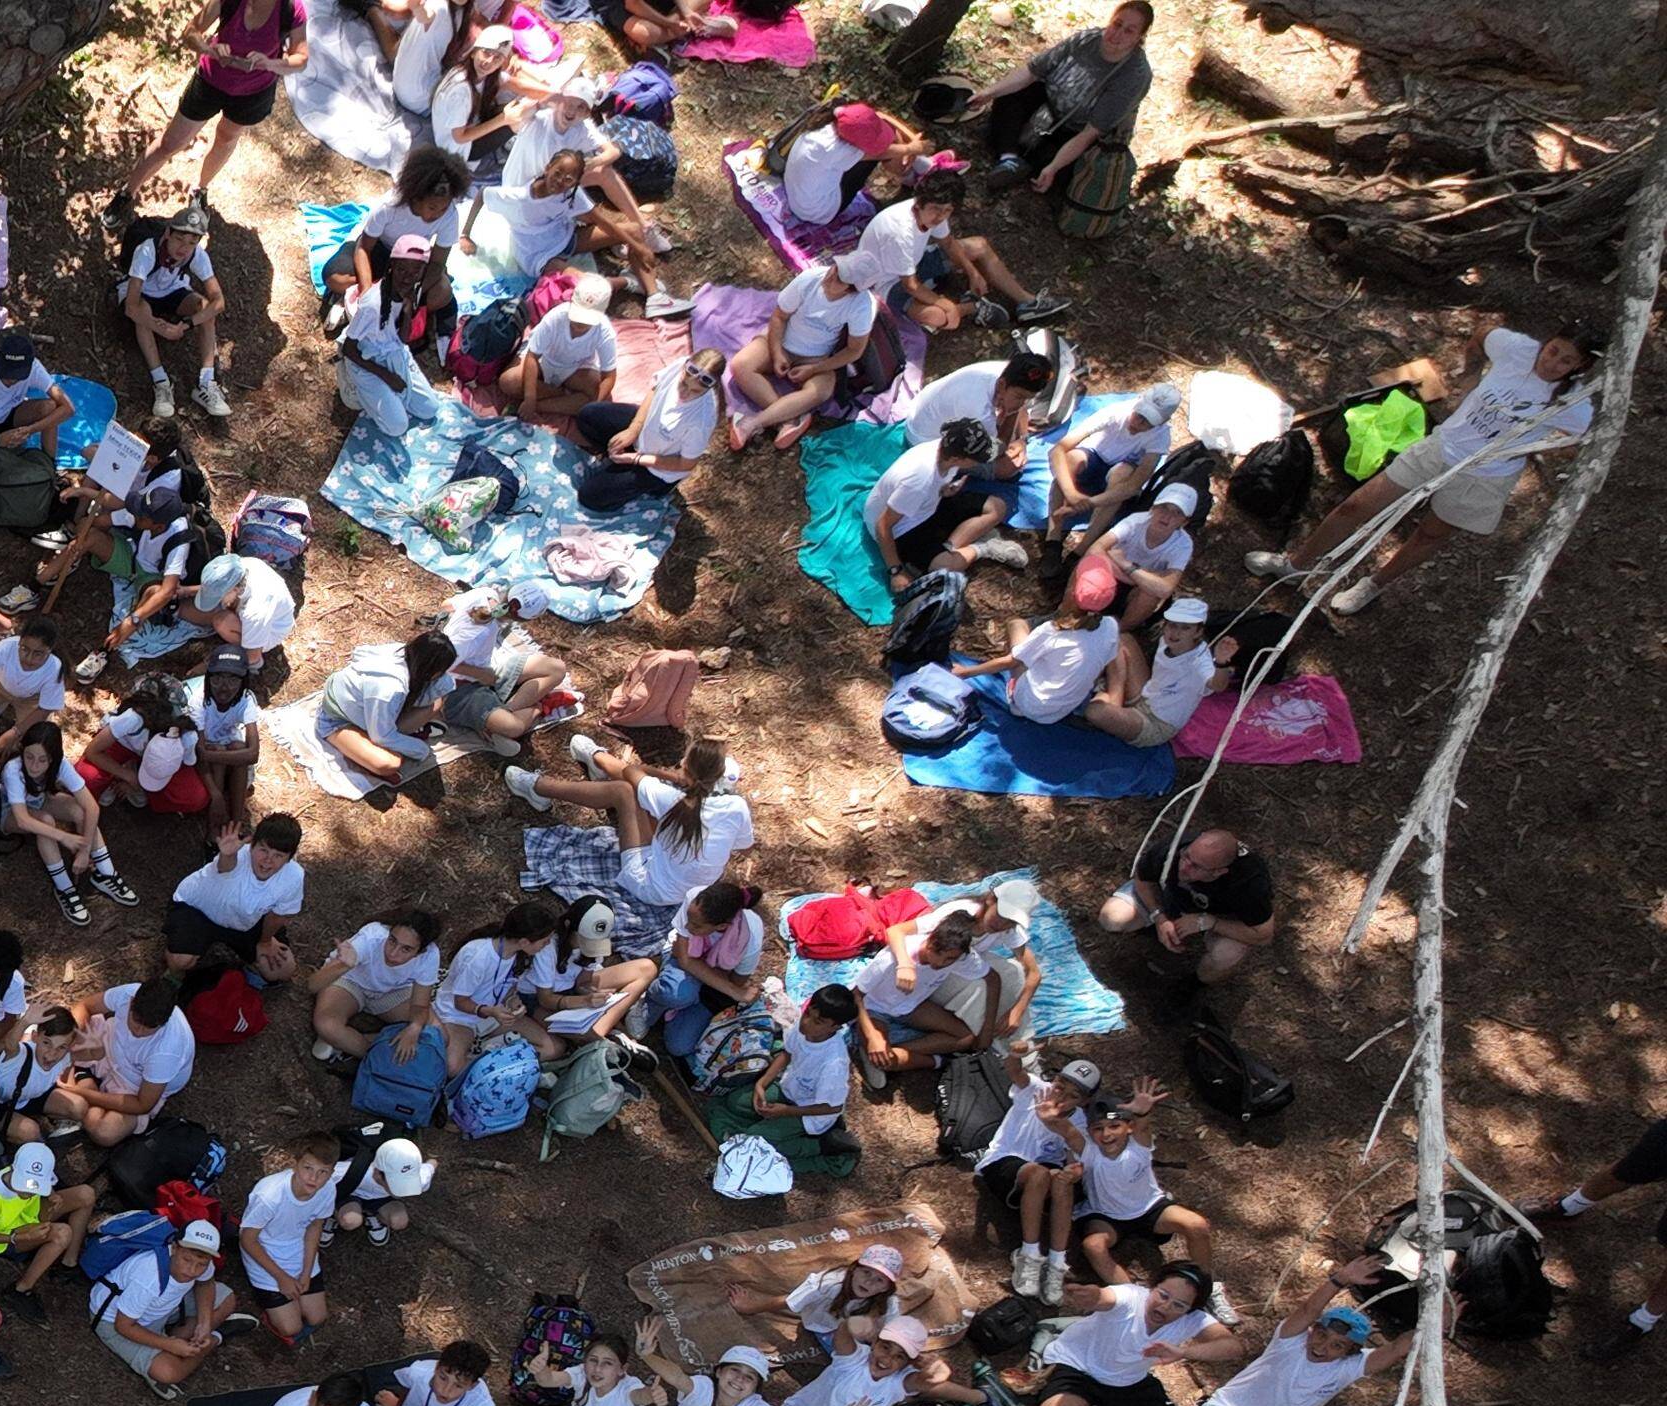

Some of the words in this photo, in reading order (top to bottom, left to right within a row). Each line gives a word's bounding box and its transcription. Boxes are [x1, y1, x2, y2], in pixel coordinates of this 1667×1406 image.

[194, 1230, 214, 1242] BOSS
[800, 1232, 829, 1246] NICE
[651, 1251, 698, 1272] MENTON
